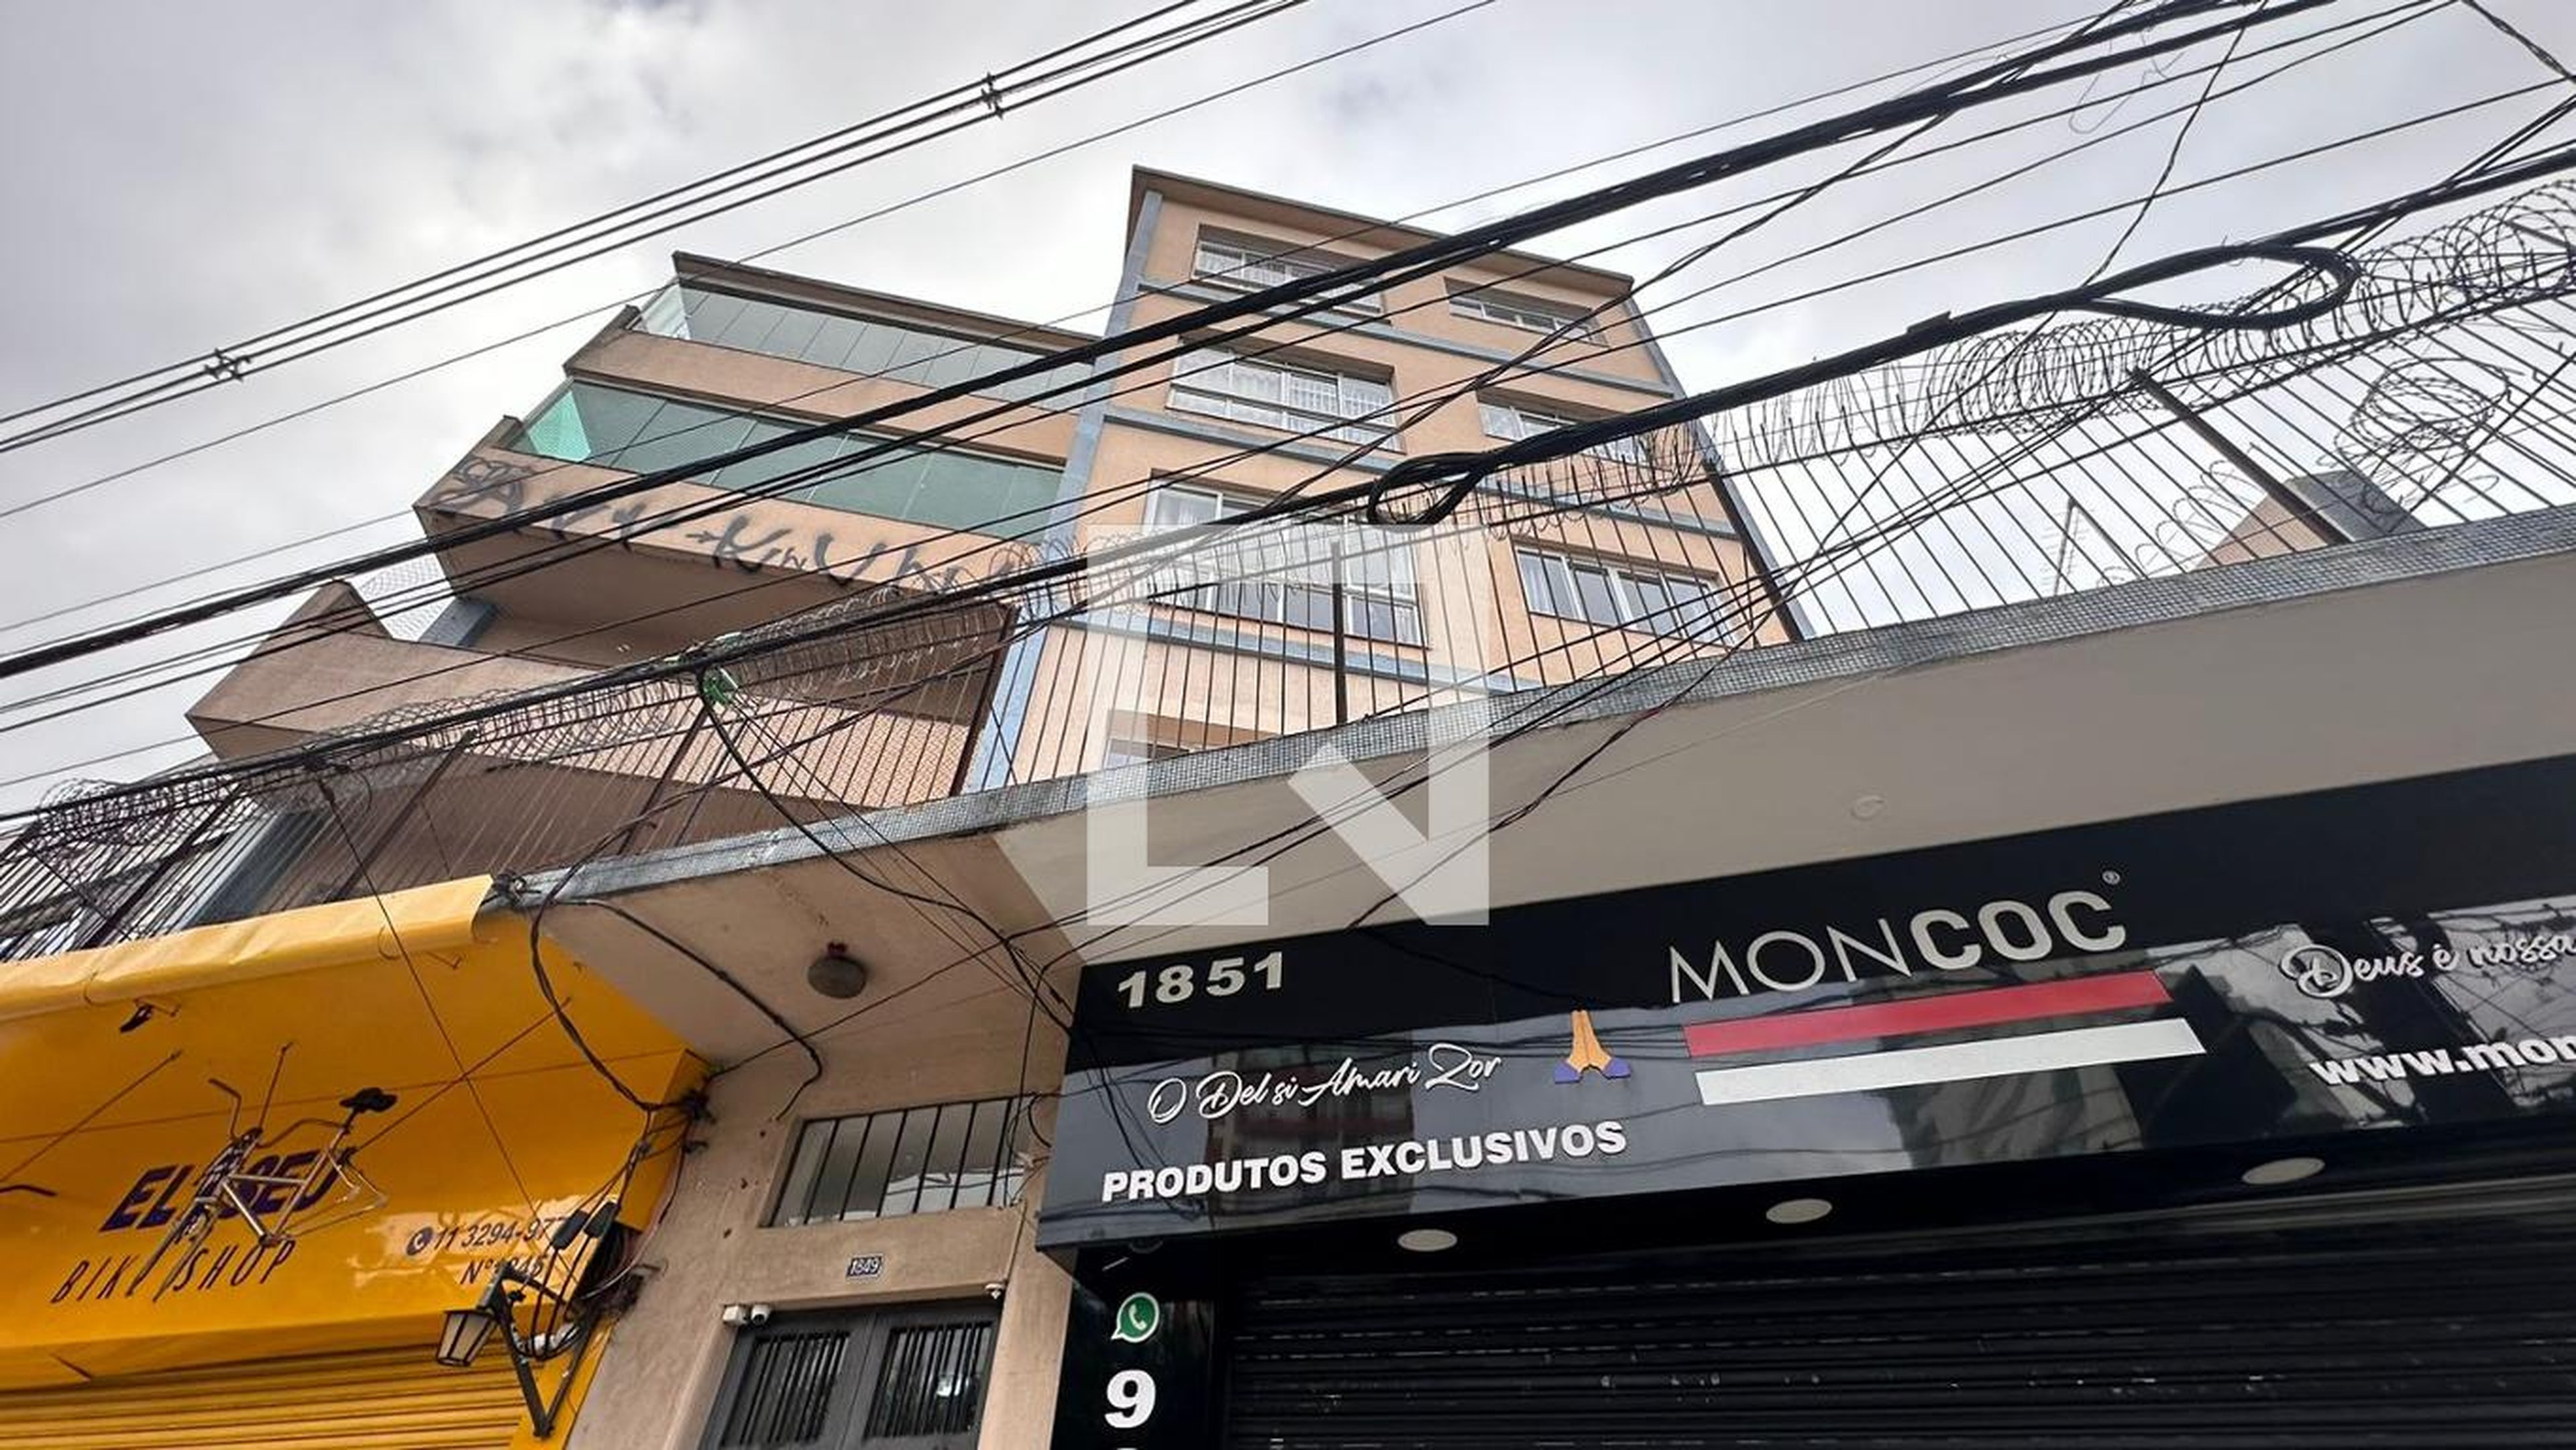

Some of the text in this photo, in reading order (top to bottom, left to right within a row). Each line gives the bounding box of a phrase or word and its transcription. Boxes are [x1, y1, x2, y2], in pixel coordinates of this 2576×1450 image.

[1118, 951, 1285, 1008] 1851
[2281, 944, 2424, 998] Deus
[1148, 1078, 1187, 1124] O
[1195, 1070, 1272, 1119] Del
[1297, 1057, 1421, 1107] Amari
[1424, 1043, 1502, 1092] Zor
[1102, 1121, 1627, 1202] PRODUTOS EXCLUSIVOS
[50, 1253, 150, 1303] BIK
[850, 1257, 880, 1275] 1849
